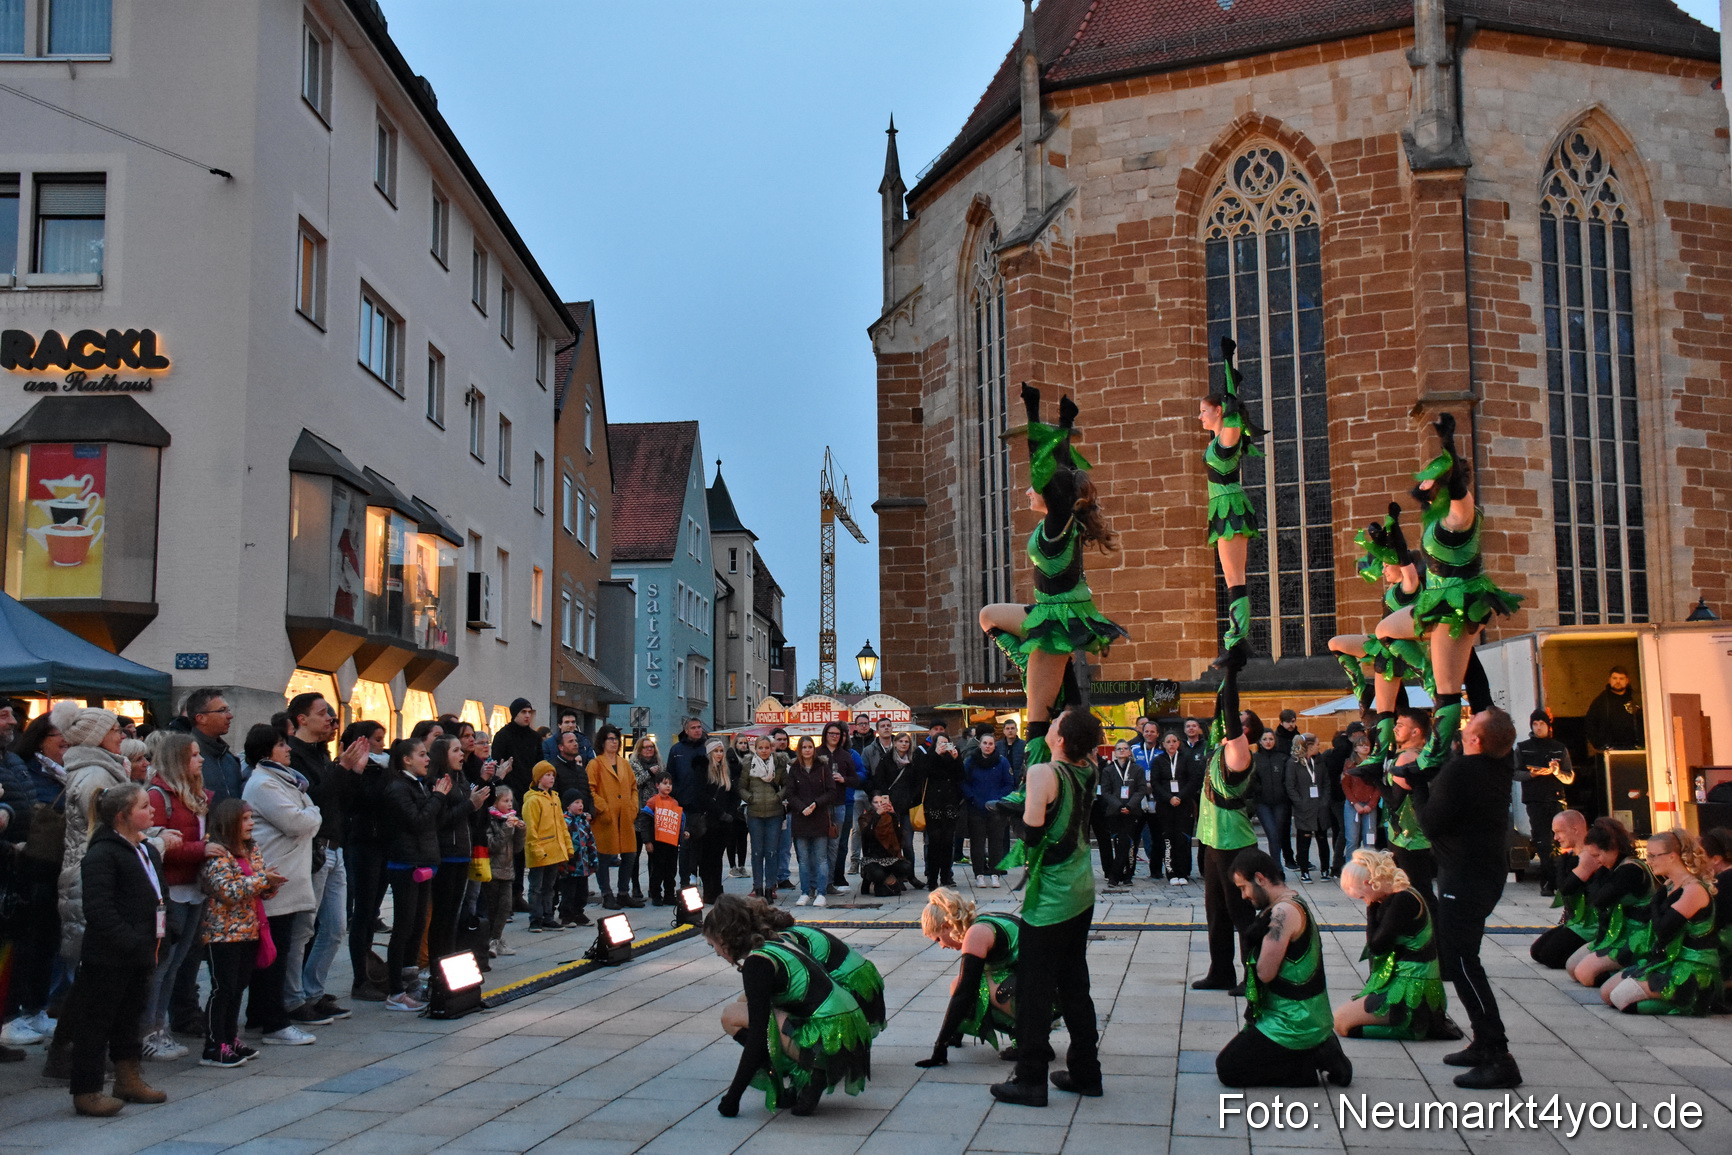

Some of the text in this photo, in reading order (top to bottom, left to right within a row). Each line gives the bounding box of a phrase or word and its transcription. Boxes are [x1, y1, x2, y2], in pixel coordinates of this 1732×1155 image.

[1, 328, 169, 370] RACKL
[23, 371, 153, 392] am Rathaus
[646, 583, 661, 687] satzke
[1089, 682, 1141, 693] NSKUECHE.DE
[755, 712, 785, 723] MANDELN
[656, 820, 678, 831] EISEN
